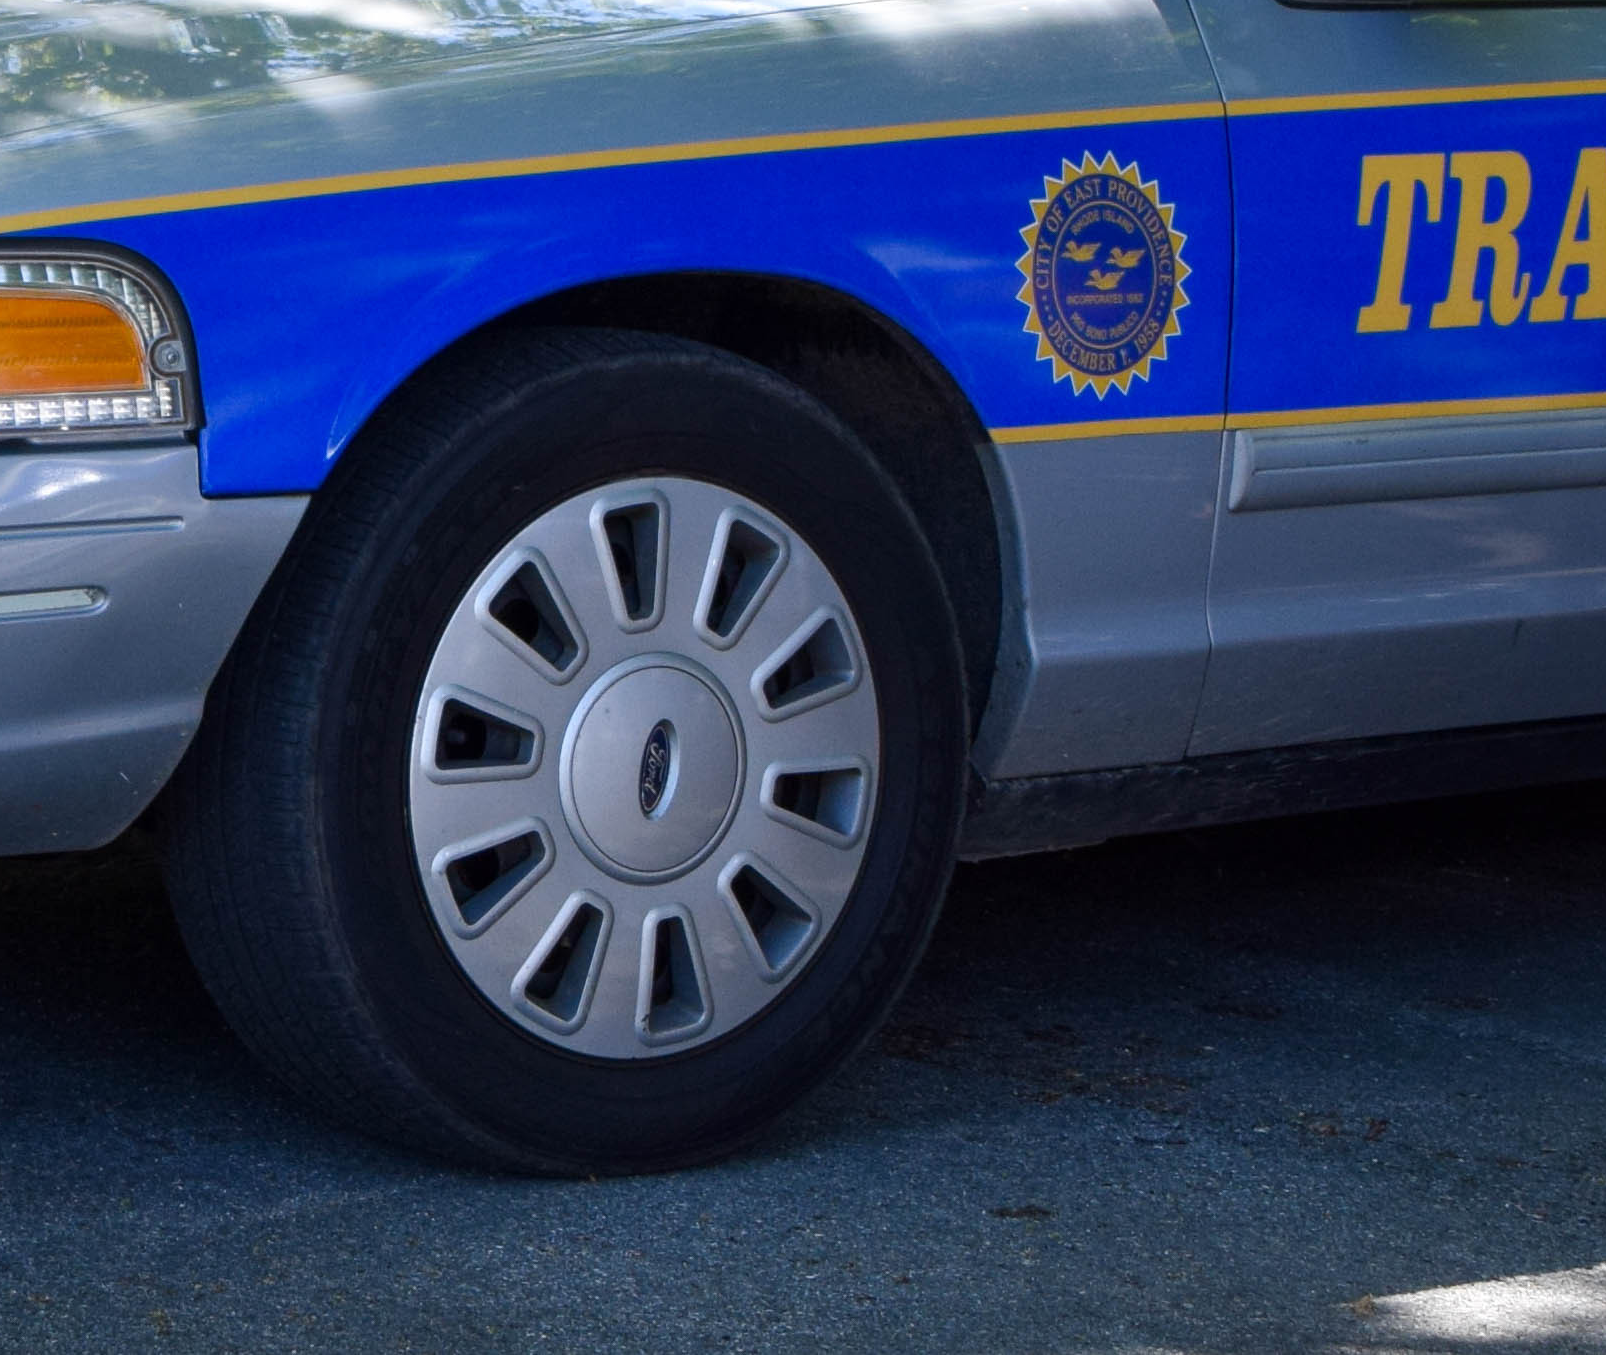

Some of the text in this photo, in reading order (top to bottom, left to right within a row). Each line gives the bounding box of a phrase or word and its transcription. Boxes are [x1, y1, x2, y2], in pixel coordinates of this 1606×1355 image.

[1035, 178, 1173, 289] CITY OF EAST PROVIDENCE
[1071, 209, 1134, 235] RHODE ISLAND
[1048, 322, 1116, 372] DECEMBER
[1135, 320, 1160, 356] 1958
[644, 743, 666, 795] Ford
